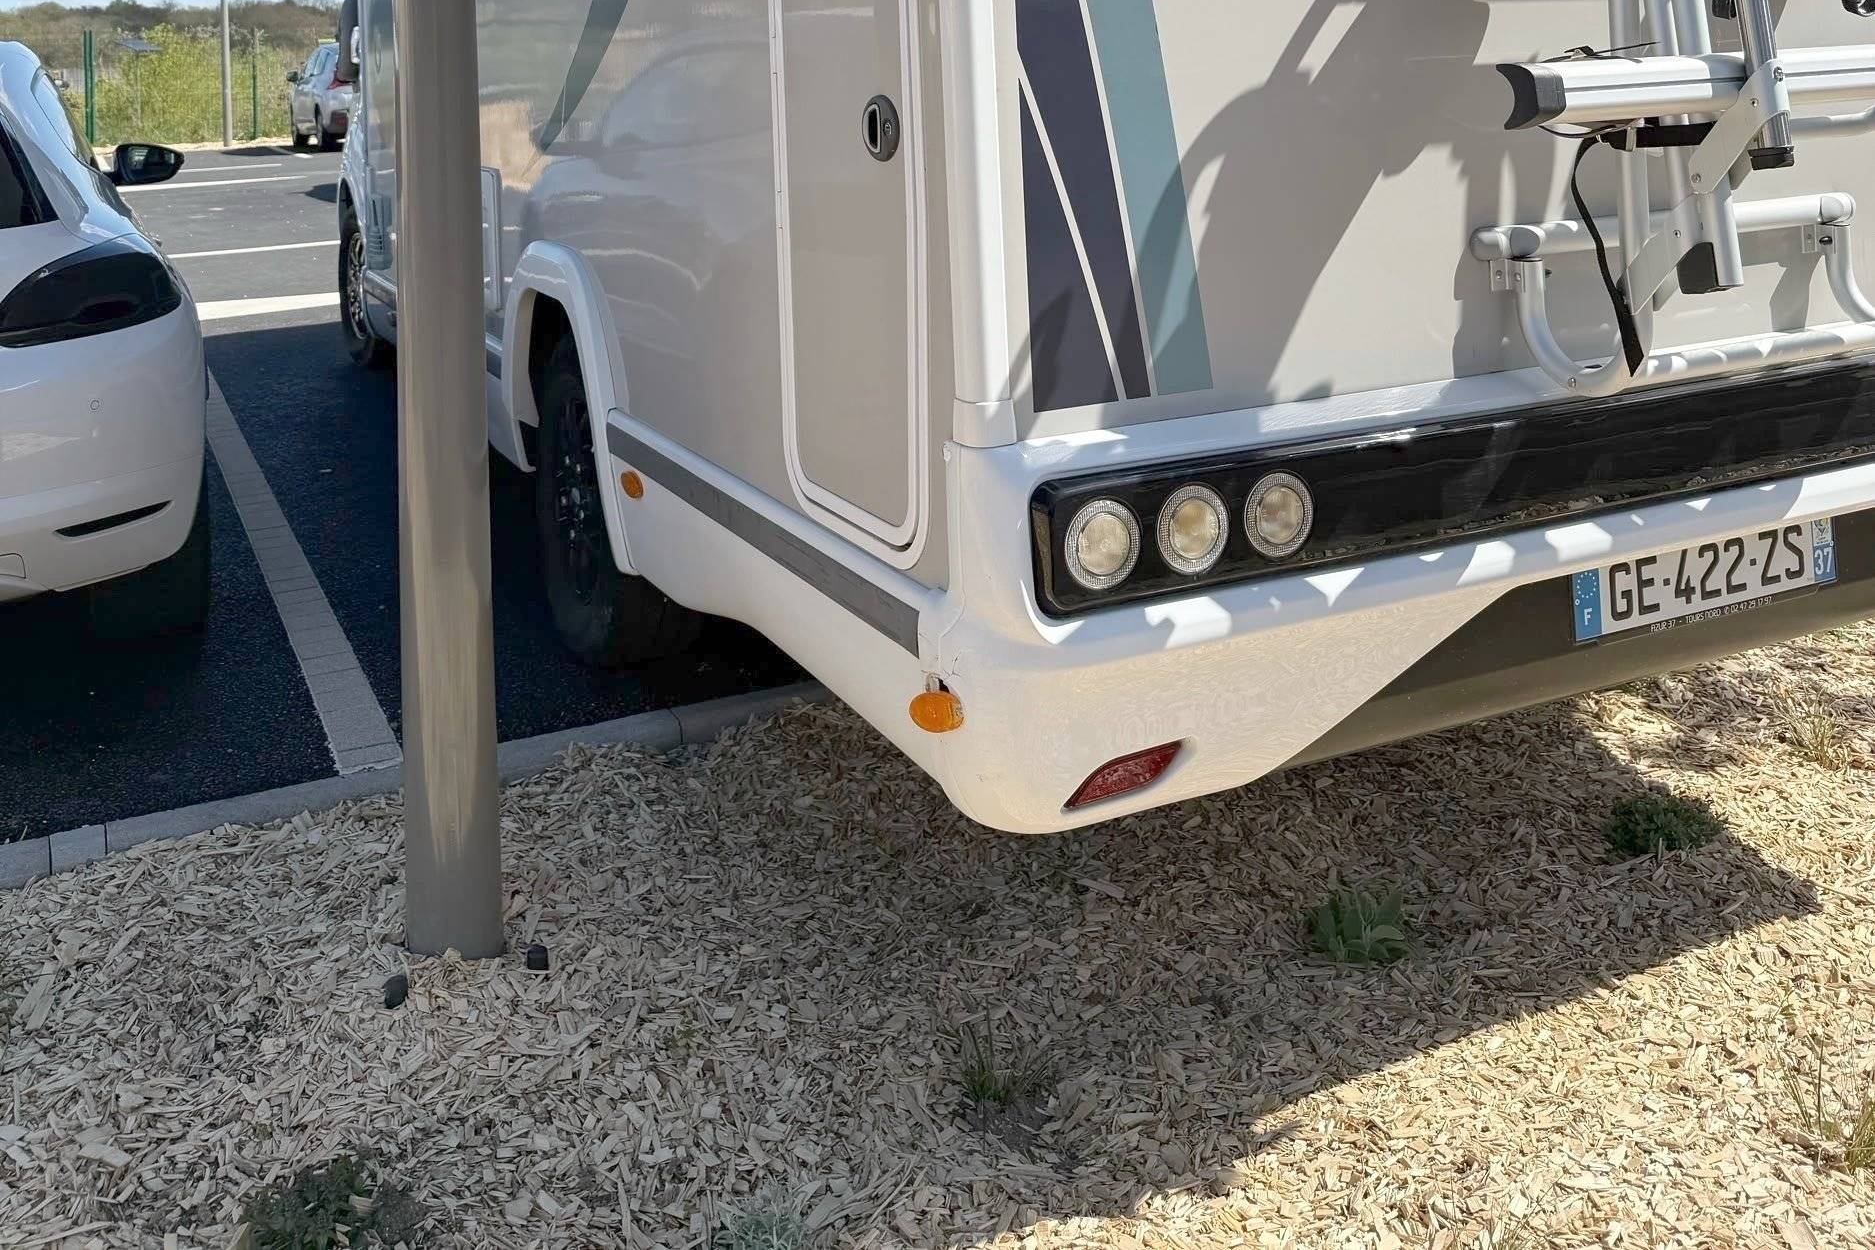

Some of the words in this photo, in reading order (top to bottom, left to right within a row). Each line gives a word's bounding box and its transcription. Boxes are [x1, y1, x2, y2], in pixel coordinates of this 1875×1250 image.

[1609, 523, 1805, 622] GE-422-ZS
[1815, 547, 1832, 575] 37
[1584, 607, 1593, 626] F
[1650, 622, 1667, 632] AZUR
[1667, 619, 1676, 629] 37
[1686, 613, 1704, 623] TOURS
[1705, 608, 1721, 619] NORD
[1731, 605, 1739, 613] 02
